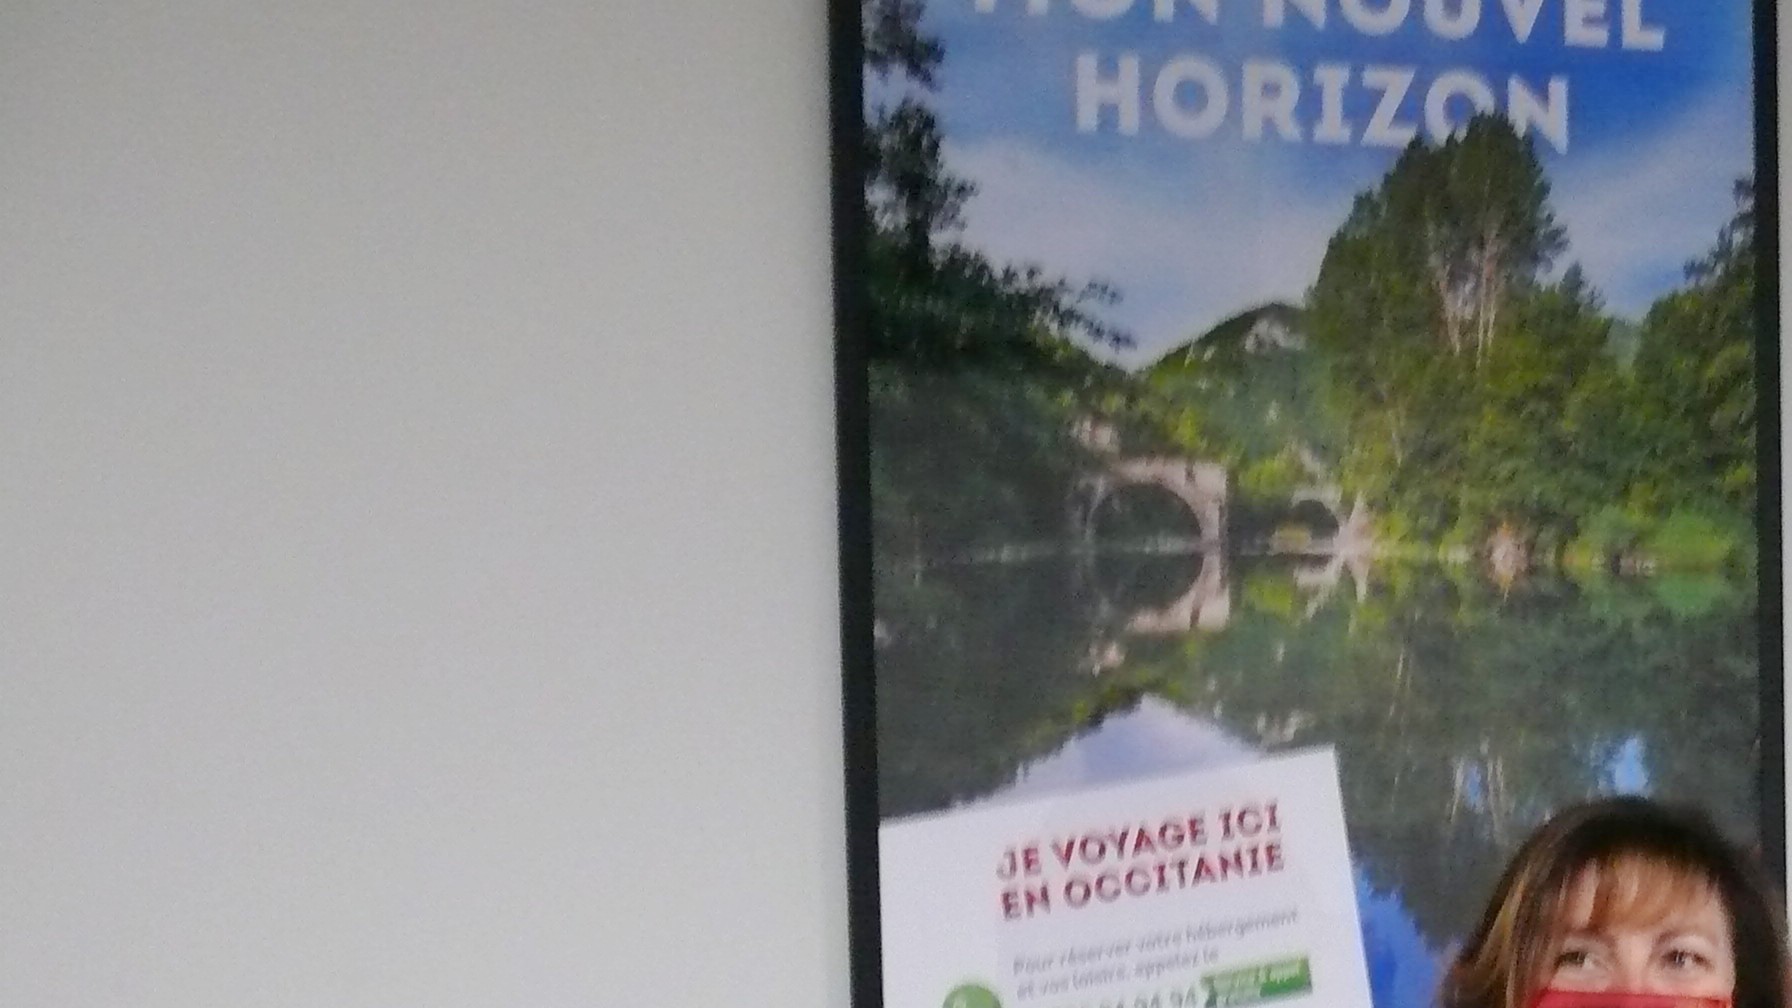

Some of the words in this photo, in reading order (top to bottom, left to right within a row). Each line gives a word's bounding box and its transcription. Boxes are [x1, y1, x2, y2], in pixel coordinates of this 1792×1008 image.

[1075, 53, 1569, 155] HORIZON
[996, 846, 1042, 880] JE
[1052, 814, 1207, 870] VOYAGE
[1219, 801, 1280, 841] ICI
[1001, 882, 1050, 921] EN
[1063, 840, 1285, 909] OCCITANIE
[1013, 953, 1053, 976] Pour
